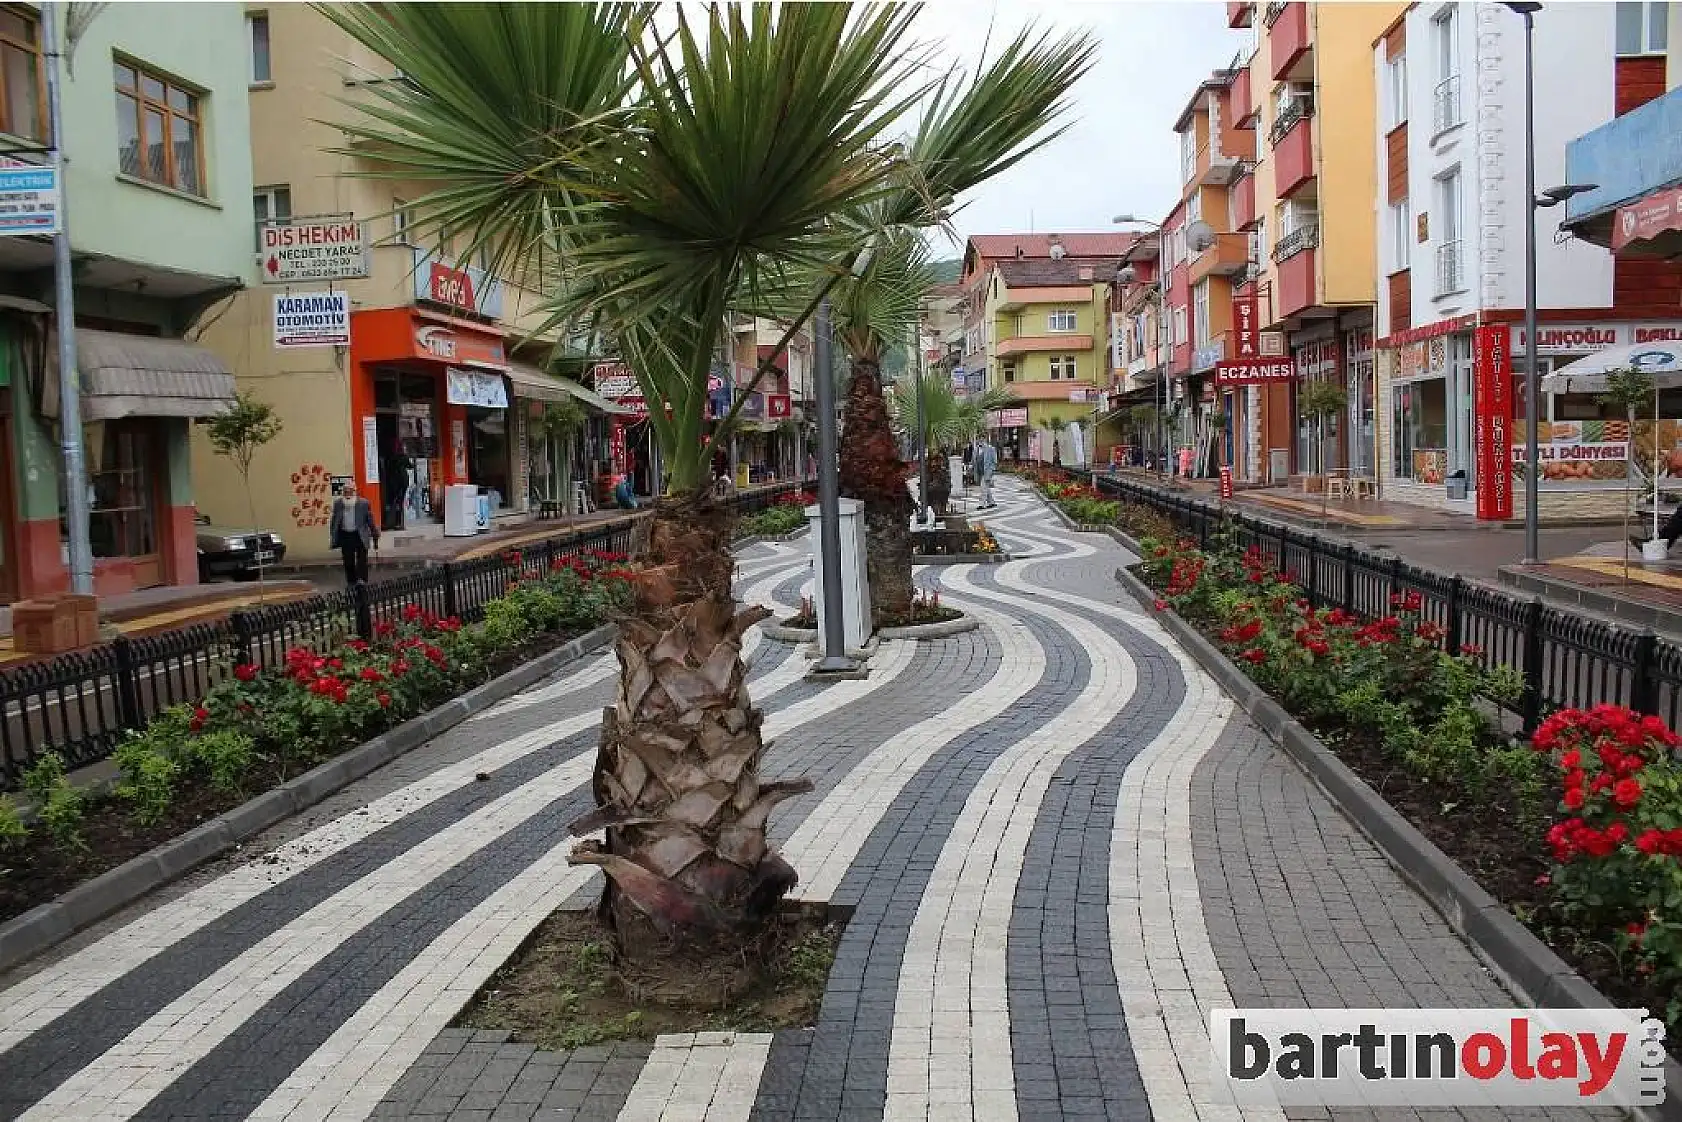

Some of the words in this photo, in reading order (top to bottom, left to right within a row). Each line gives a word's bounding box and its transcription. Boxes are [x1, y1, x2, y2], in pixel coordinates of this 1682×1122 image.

[278, 296, 343, 314] KARAMAN
[1519, 326, 1616, 348] KLINÇOĞLU
[1635, 326, 1682, 343] BAKL
[1219, 361, 1295, 380] ECZANESİ
[1512, 447, 1555, 461] TLI
[1559, 444, 1626, 459] DÜNYASI
